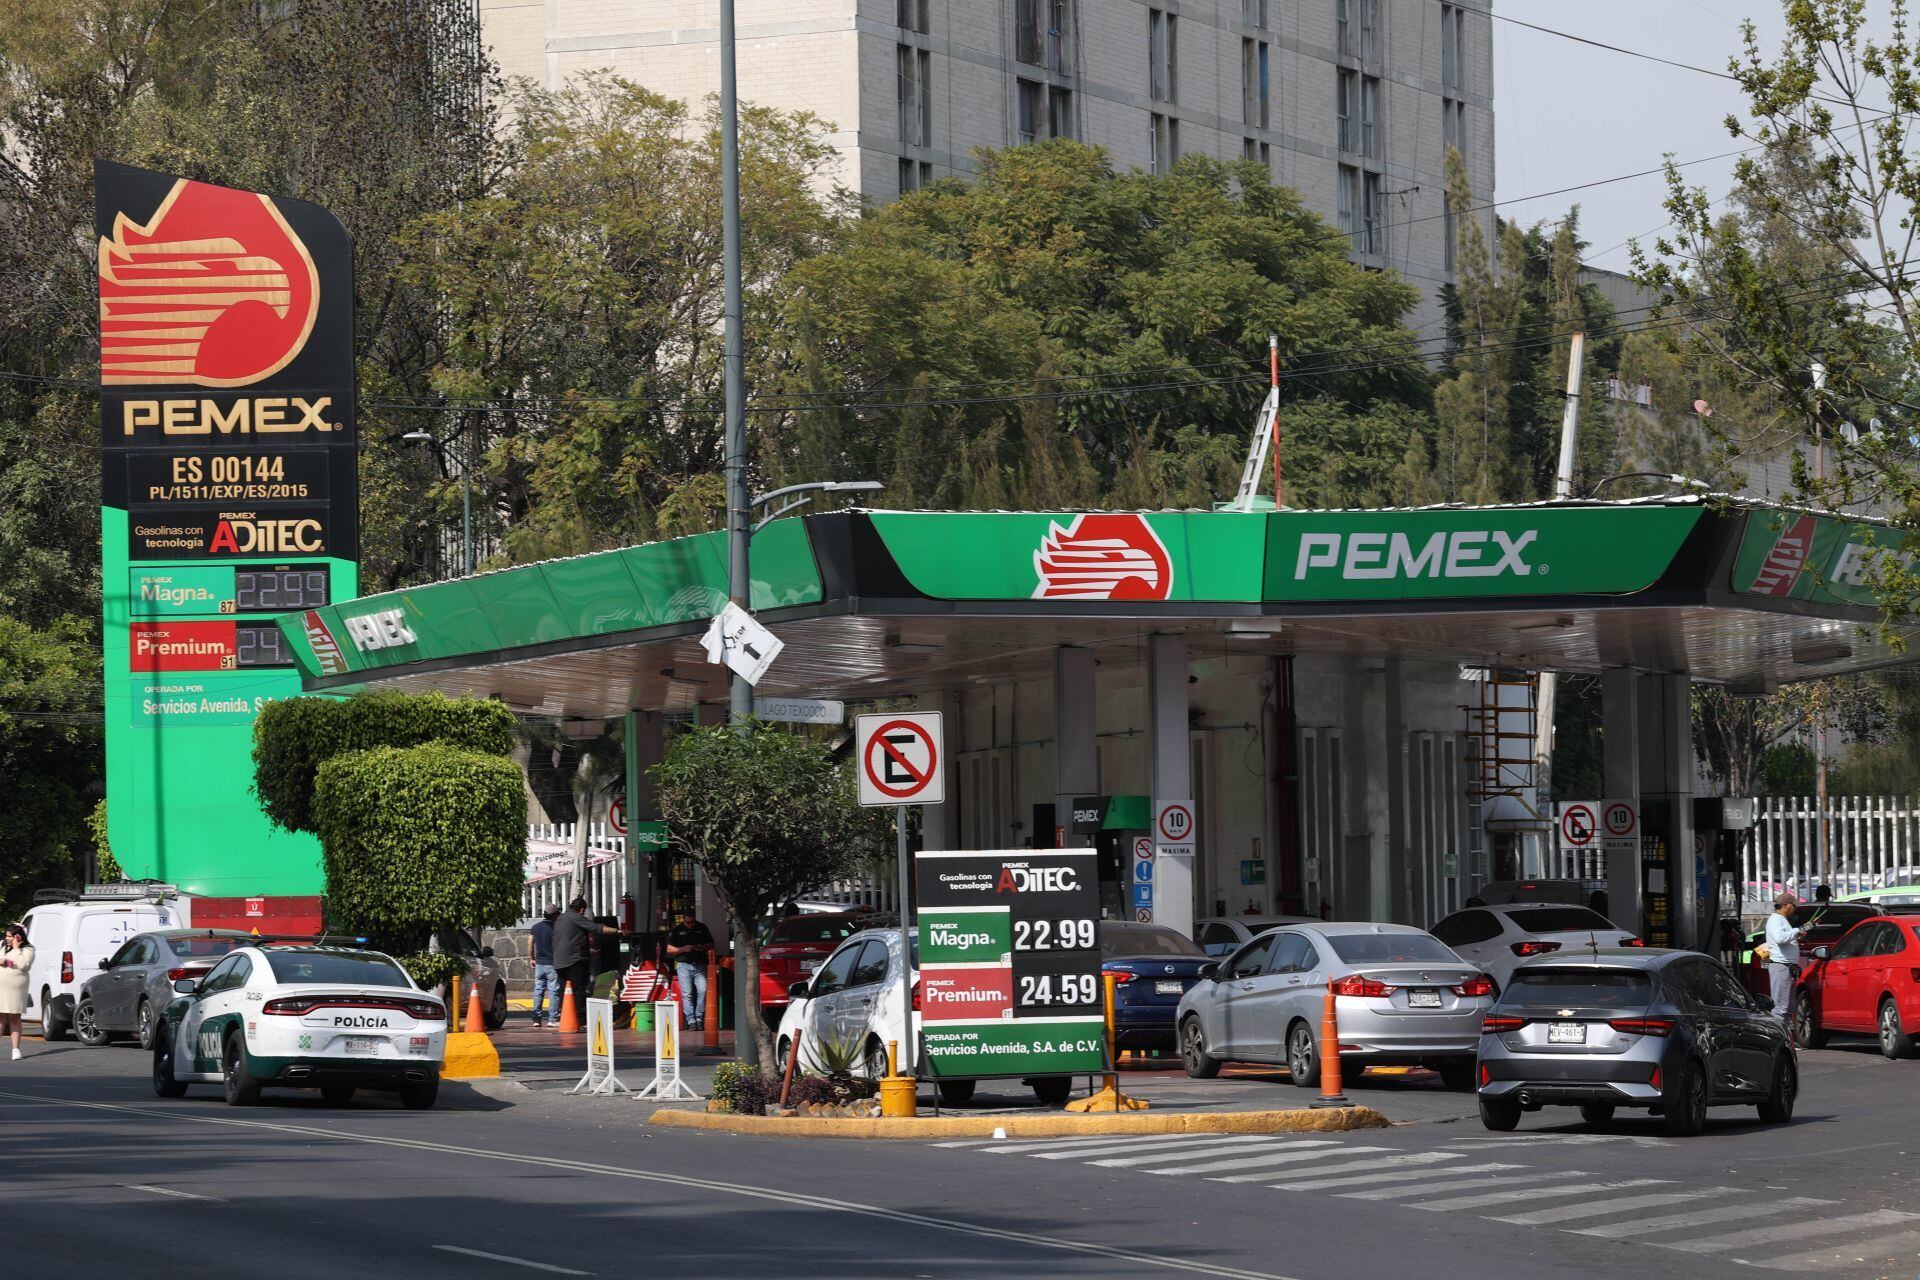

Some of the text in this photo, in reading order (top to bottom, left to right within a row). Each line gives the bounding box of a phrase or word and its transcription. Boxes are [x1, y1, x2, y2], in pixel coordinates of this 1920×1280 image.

[123, 397, 331, 435] PEMEX
[172, 456, 284, 483] ES 00144
[149, 484, 308, 500] PL/1511/EXP/ES/2015
[135, 525, 203, 536] Gasolinas con
[1294, 530, 1538, 580] PEMEX
[141, 585, 207, 606] Magna
[220, 601, 233, 613] 87
[137, 638, 224, 655] Premium
[221, 656, 234, 668] 91
[144, 685, 184, 693] OPERADA
[143, 699, 197, 715] Servicios
[200, 698, 251, 714] Avenida,
[765, 704, 786, 716] LAGO
[1073, 809, 1098, 822] PEMEX
[1169, 813, 1184, 828] 10
[1613, 810, 1627, 823] 10
[939, 873, 976, 882] Gasolinas
[930, 930, 989, 950] Magna
[1014, 919, 1095, 950] 22.99
[926, 987, 1001, 1003] Premium
[1020, 975, 1097, 1006] 24.59
[925, 1040, 1100, 1056] Servicios Avenida, S.A. de C.V.
